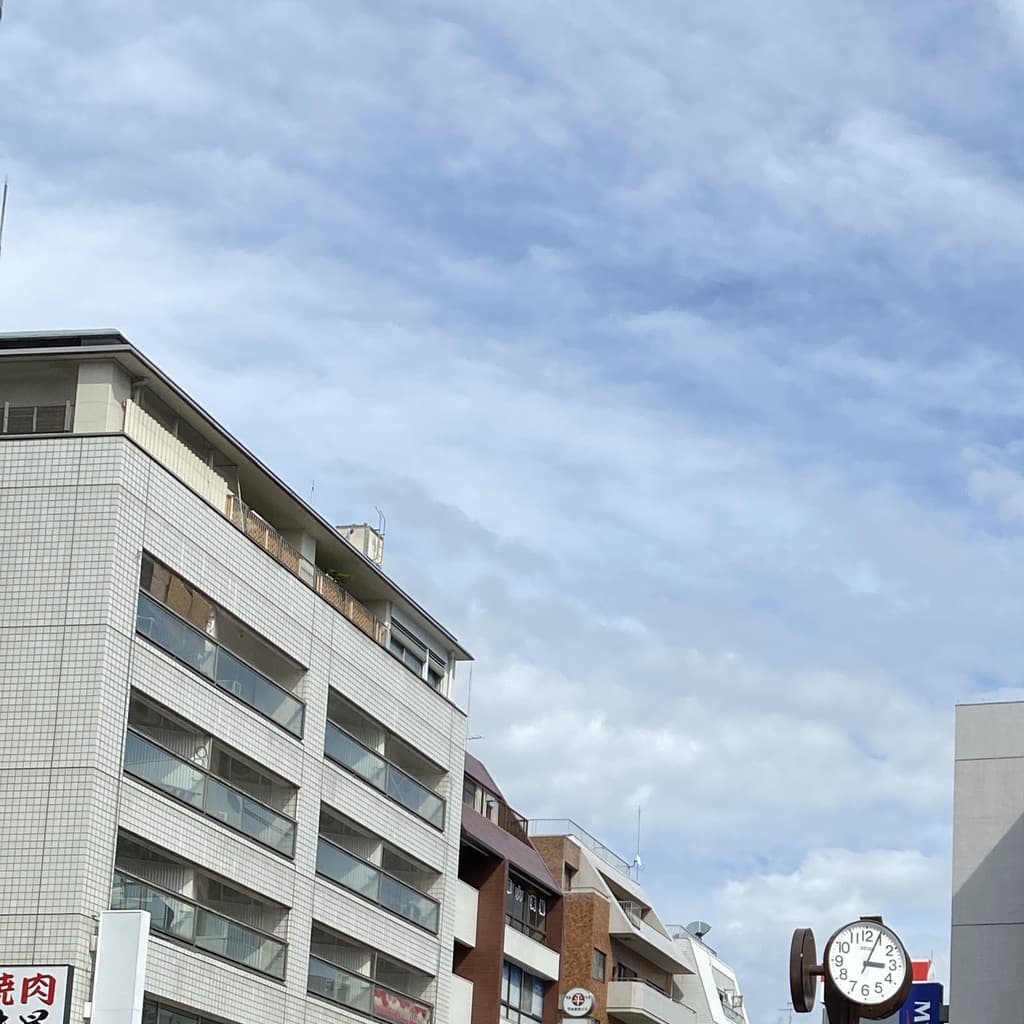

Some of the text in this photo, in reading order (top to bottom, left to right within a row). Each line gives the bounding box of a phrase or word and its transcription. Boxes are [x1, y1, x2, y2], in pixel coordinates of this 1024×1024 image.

[850, 932, 859, 944] 11
[862, 929, 874, 943] 12
[838, 941, 851, 954] 10
[885, 945, 894, 956] 2
[834, 955, 844, 967] 9
[888, 959, 897, 971] 3
[839, 968, 848, 980] 8
[884, 973, 893, 984] 4
[849, 980, 858, 992] 7
[860, 984, 870, 996] 6
[874, 982, 883, 994] 5
